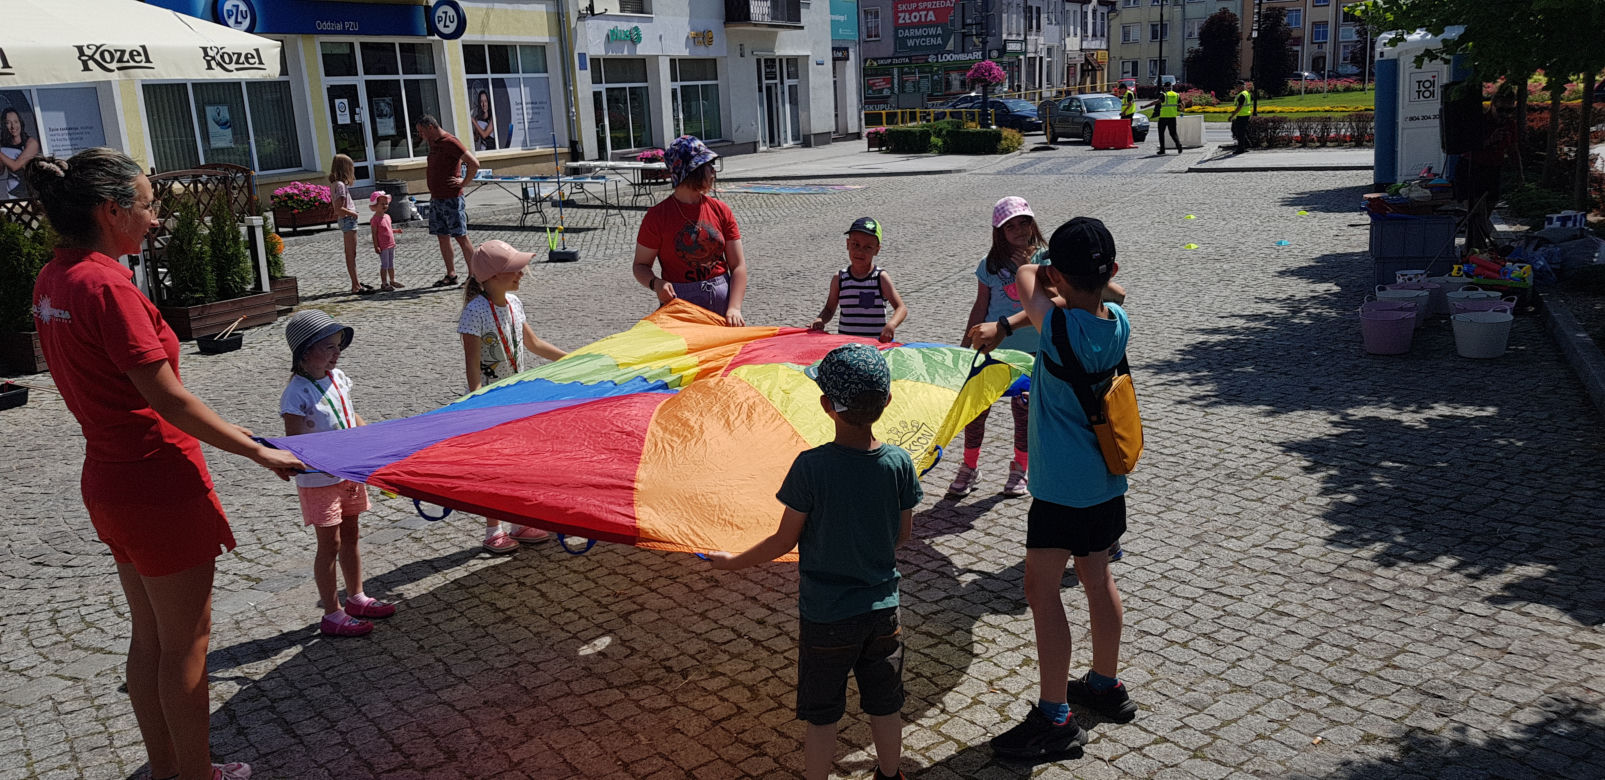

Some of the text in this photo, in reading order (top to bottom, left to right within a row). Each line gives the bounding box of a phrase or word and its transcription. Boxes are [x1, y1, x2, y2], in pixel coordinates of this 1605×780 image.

[897, 2, 917, 11] SKUP
[226, 4, 248, 25] PZU
[437, 10, 455, 29] PZU
[898, 10, 936, 24] ZŁOTA
[316, 20, 359, 31] Oddział PZU
[898, 27, 943, 38] DARMOWA
[906, 37, 943, 47] WYCENA
[73, 43, 155, 73] Kozel
[200, 45, 267, 72] Kozel
[938, 51, 983, 62] LOOMBAR
[1416, 75, 1436, 89] TOI
[1416, 89, 1435, 99] TOI
